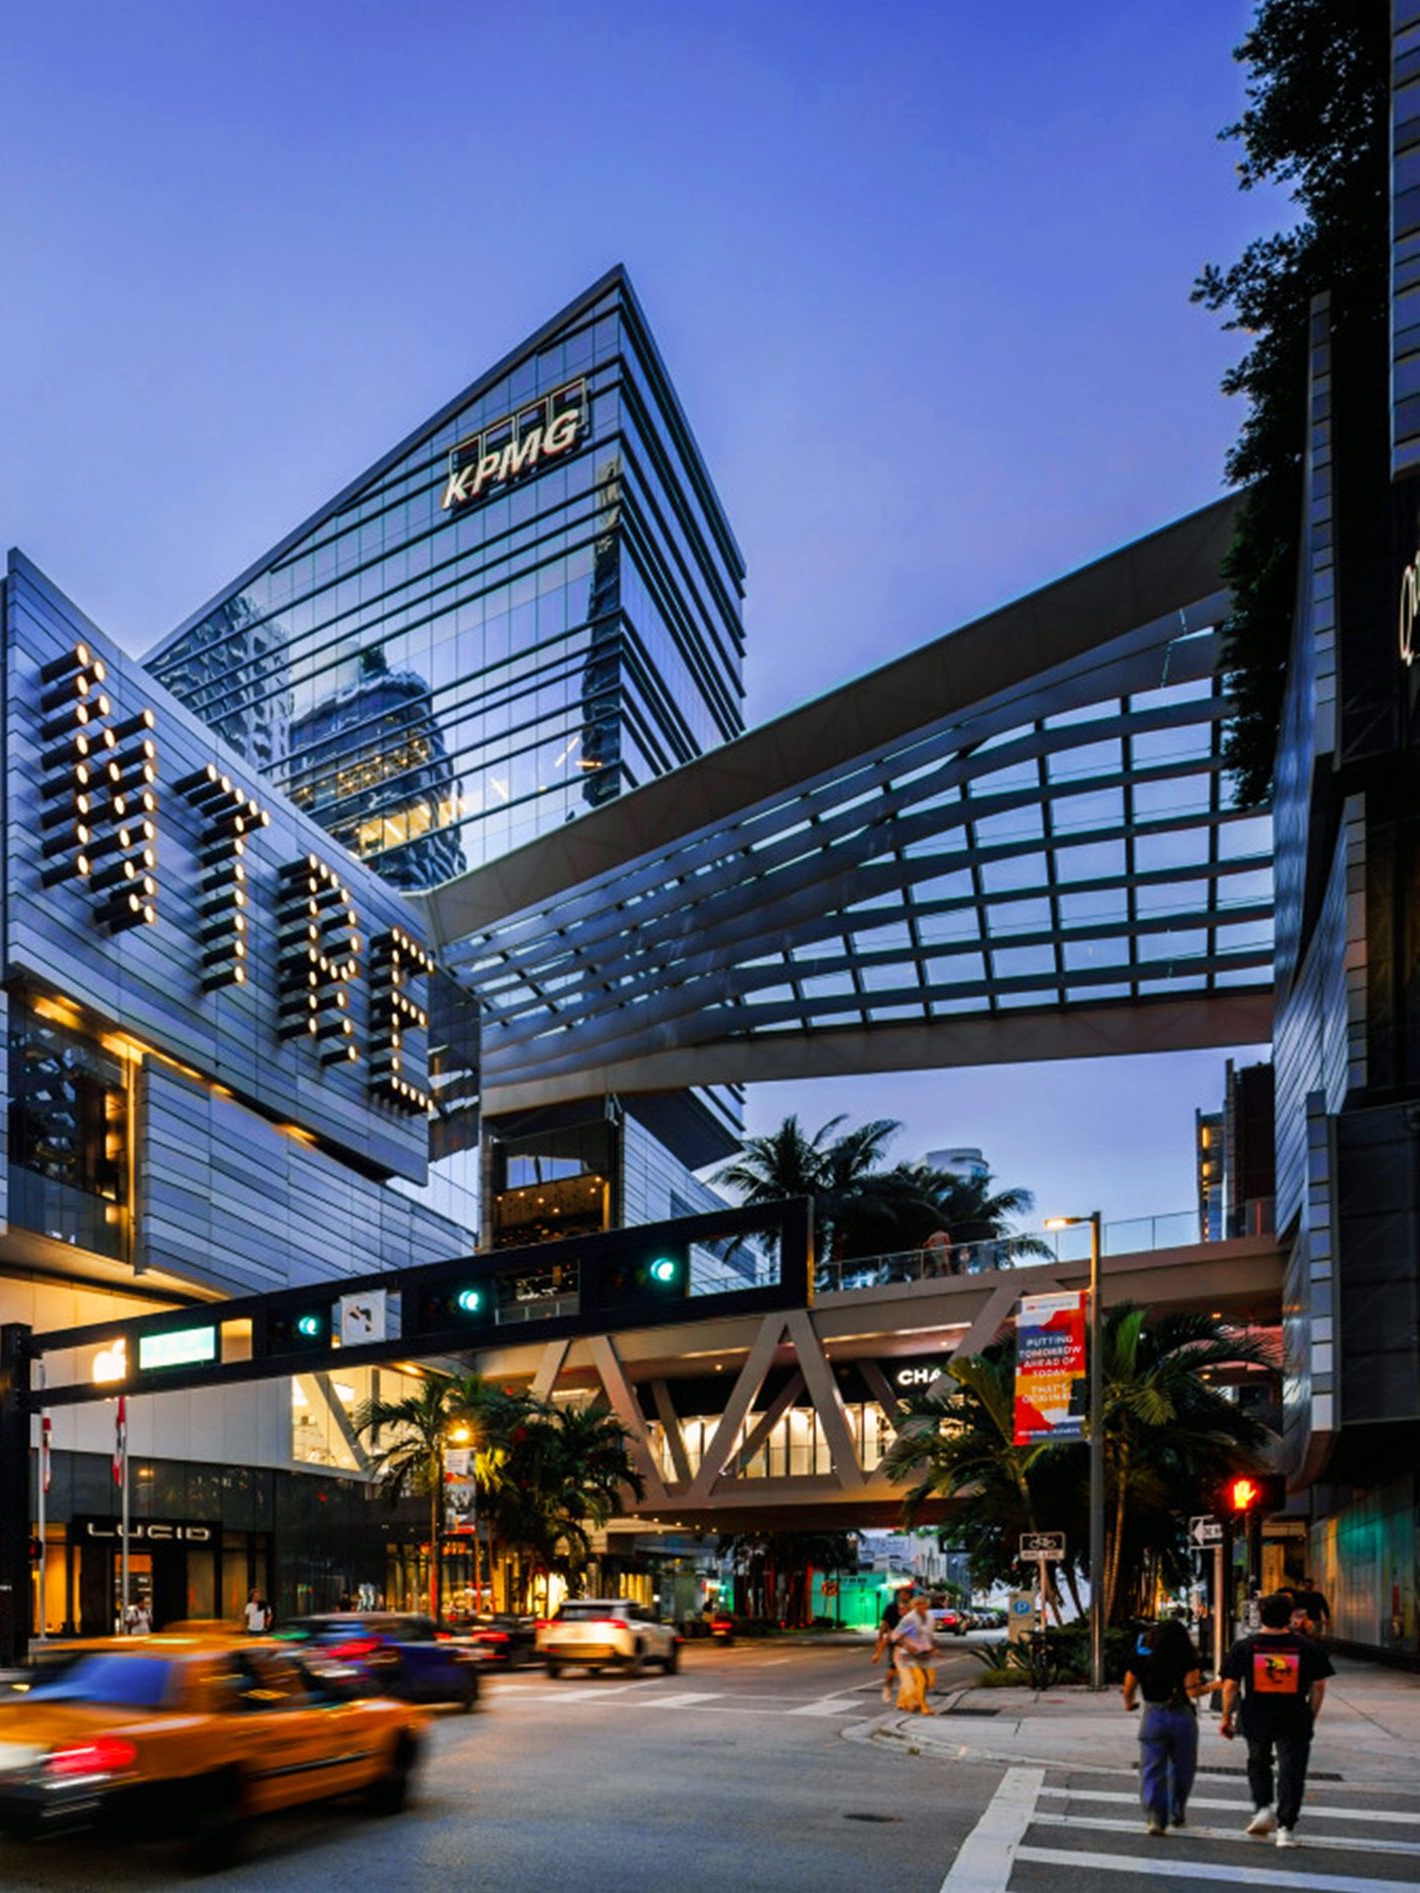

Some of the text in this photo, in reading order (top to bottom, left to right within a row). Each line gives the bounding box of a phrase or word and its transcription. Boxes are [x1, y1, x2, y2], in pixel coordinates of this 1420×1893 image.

[441, 408, 579, 511] KPMG
[1026, 1335, 1074, 1347] PUTTING
[1019, 1345, 1082, 1358] TOMORROW
[1023, 1356, 1076, 1369] AHEAD OF
[87, 1523, 211, 1541] LUCID
